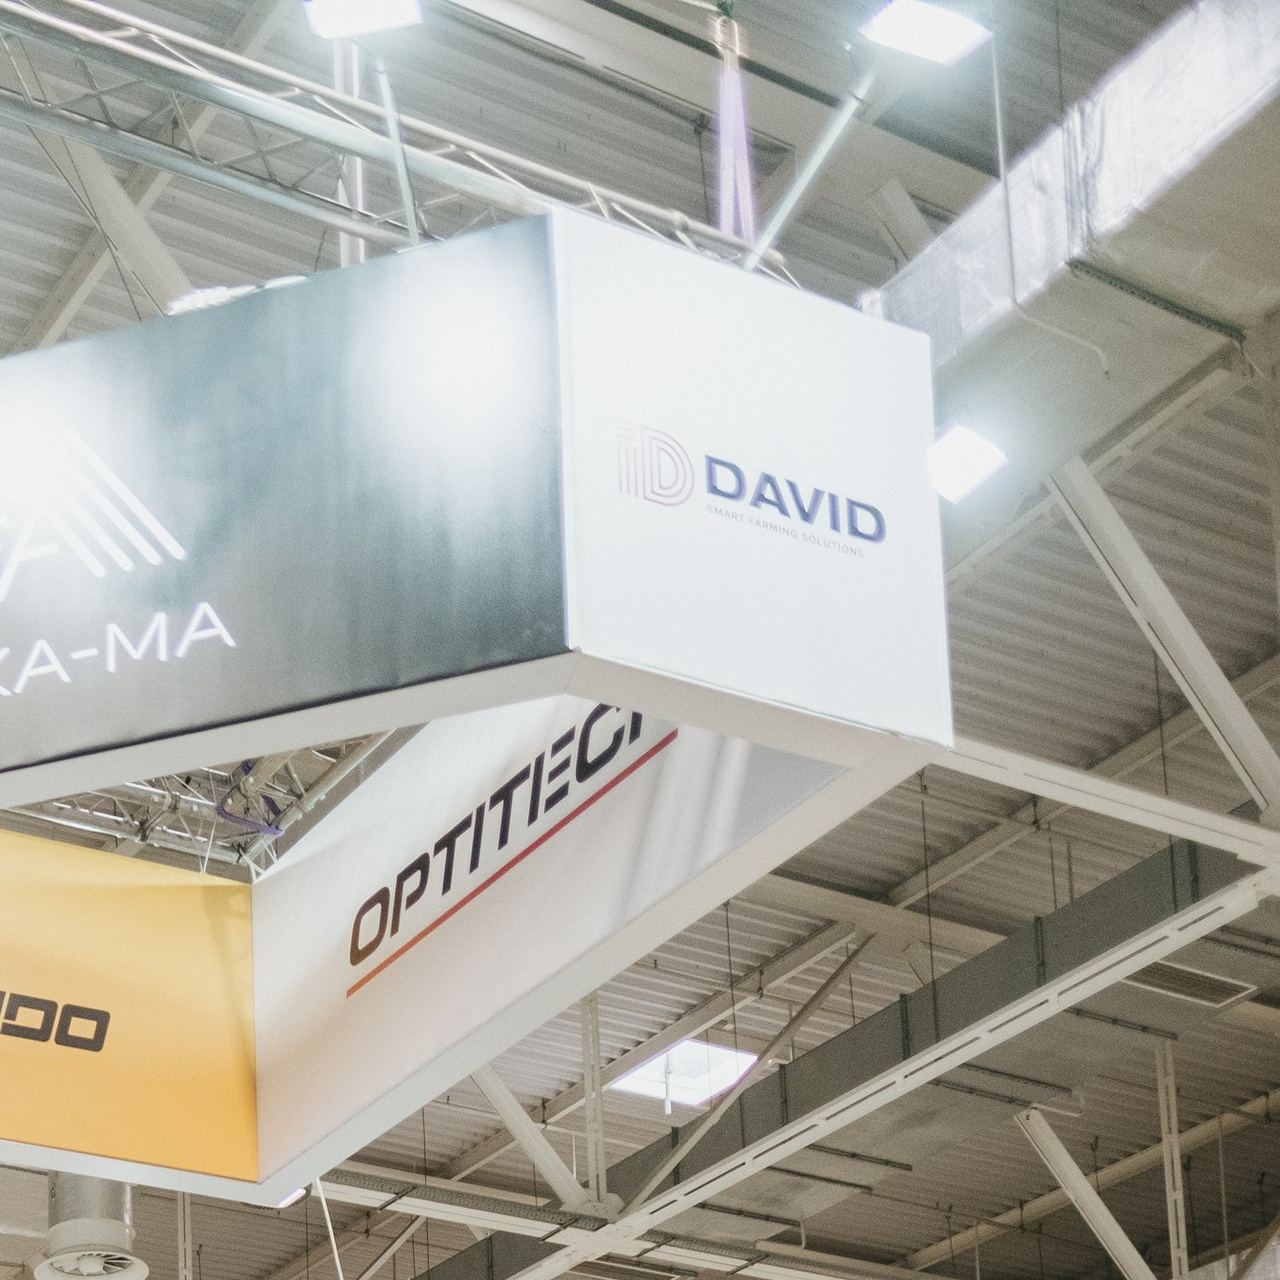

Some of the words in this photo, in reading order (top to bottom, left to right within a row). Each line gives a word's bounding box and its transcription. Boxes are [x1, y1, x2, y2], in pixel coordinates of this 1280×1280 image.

[704, 453, 887, 545] DAVID
[706, 504, 745, 523] SMART
[748, 516, 799, 540] FARMING
[801, 532, 865, 559] SOLUTIONS
